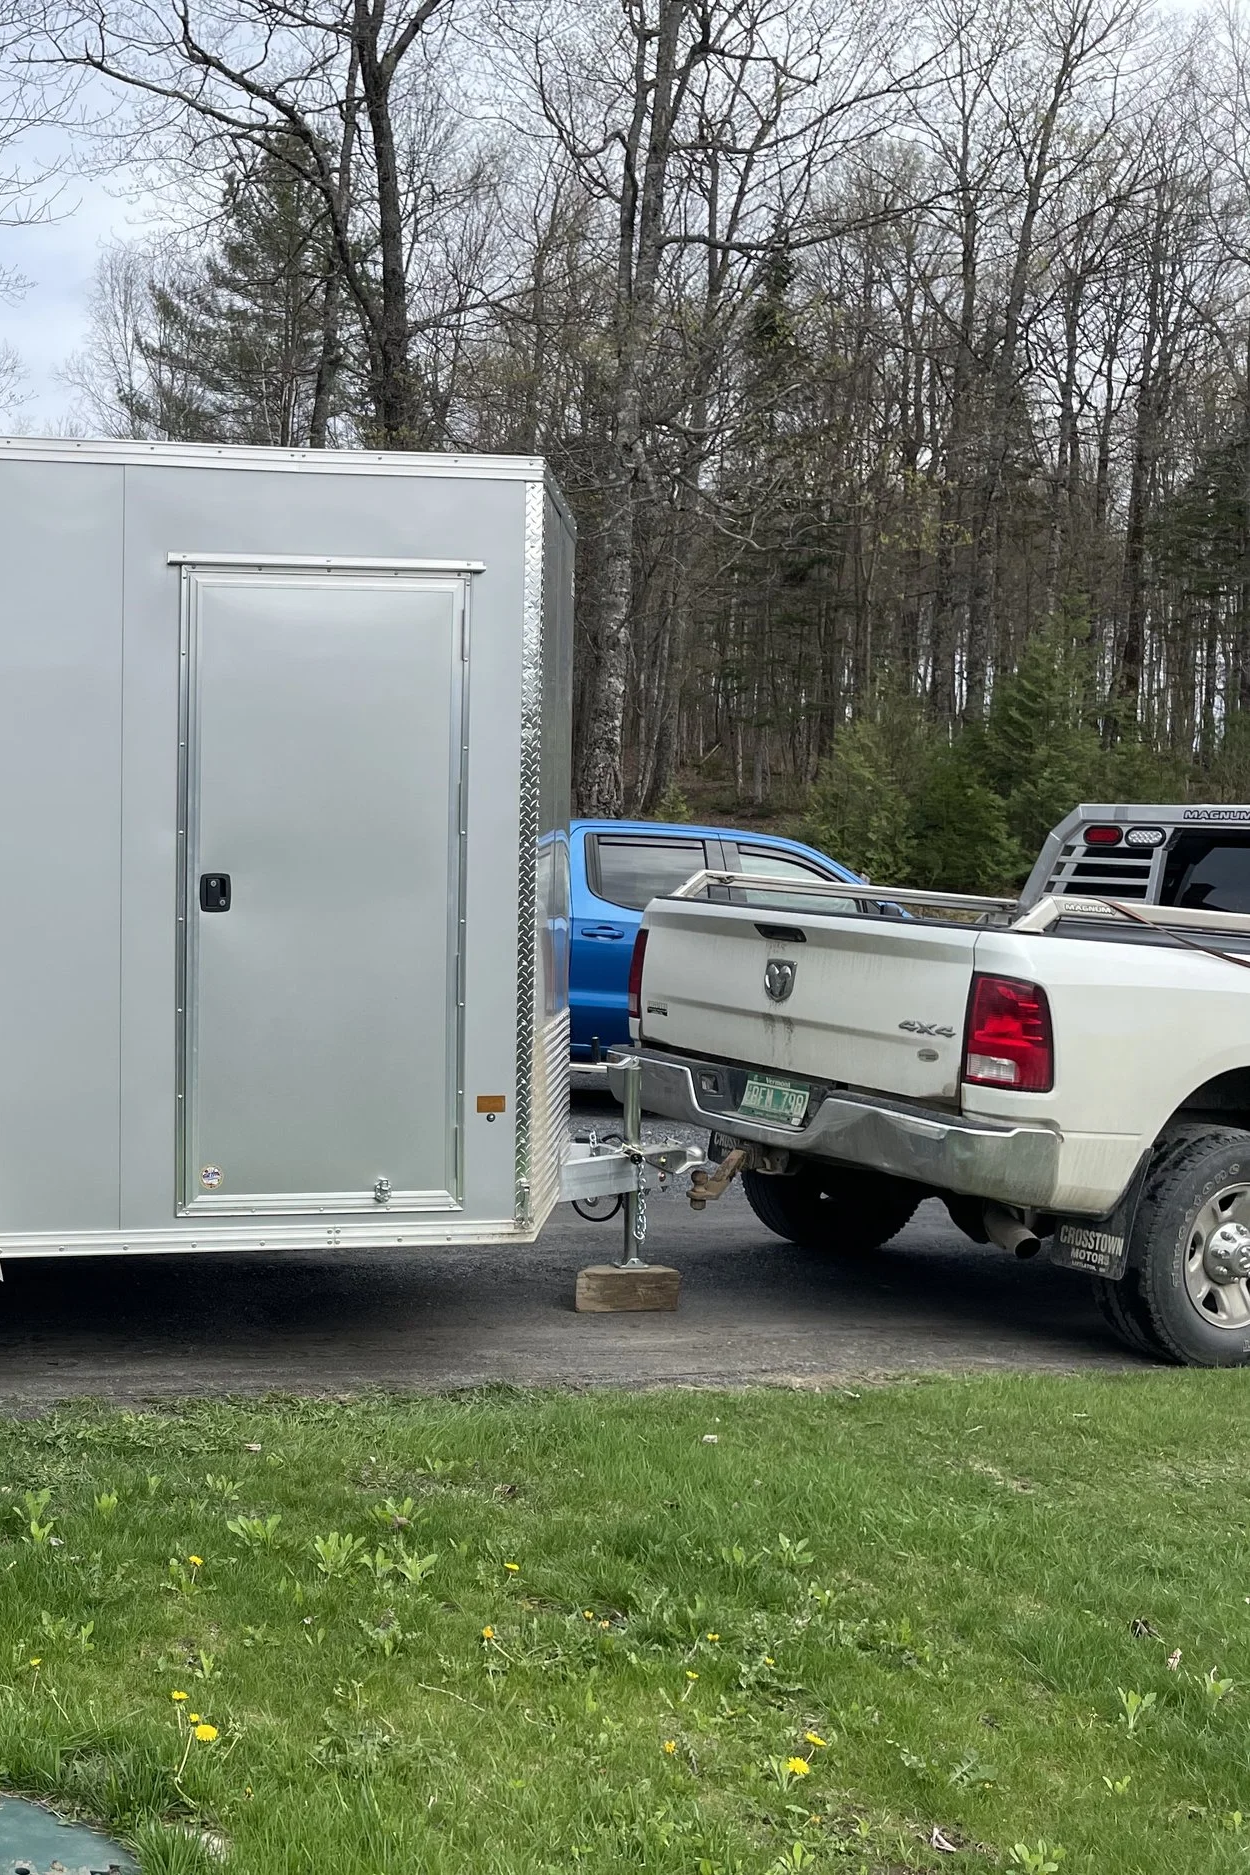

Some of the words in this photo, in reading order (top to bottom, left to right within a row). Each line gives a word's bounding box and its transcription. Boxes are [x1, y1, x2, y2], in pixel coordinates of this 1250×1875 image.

[1183, 809, 1250, 820] MAGNUM
[1064, 903, 1113, 915] MAGNUM
[765, 1076, 791, 1089] Vermont
[1059, 1224, 1125, 1257] CROSSTOWN
[1070, 1247, 1110, 1266] MOTORS
